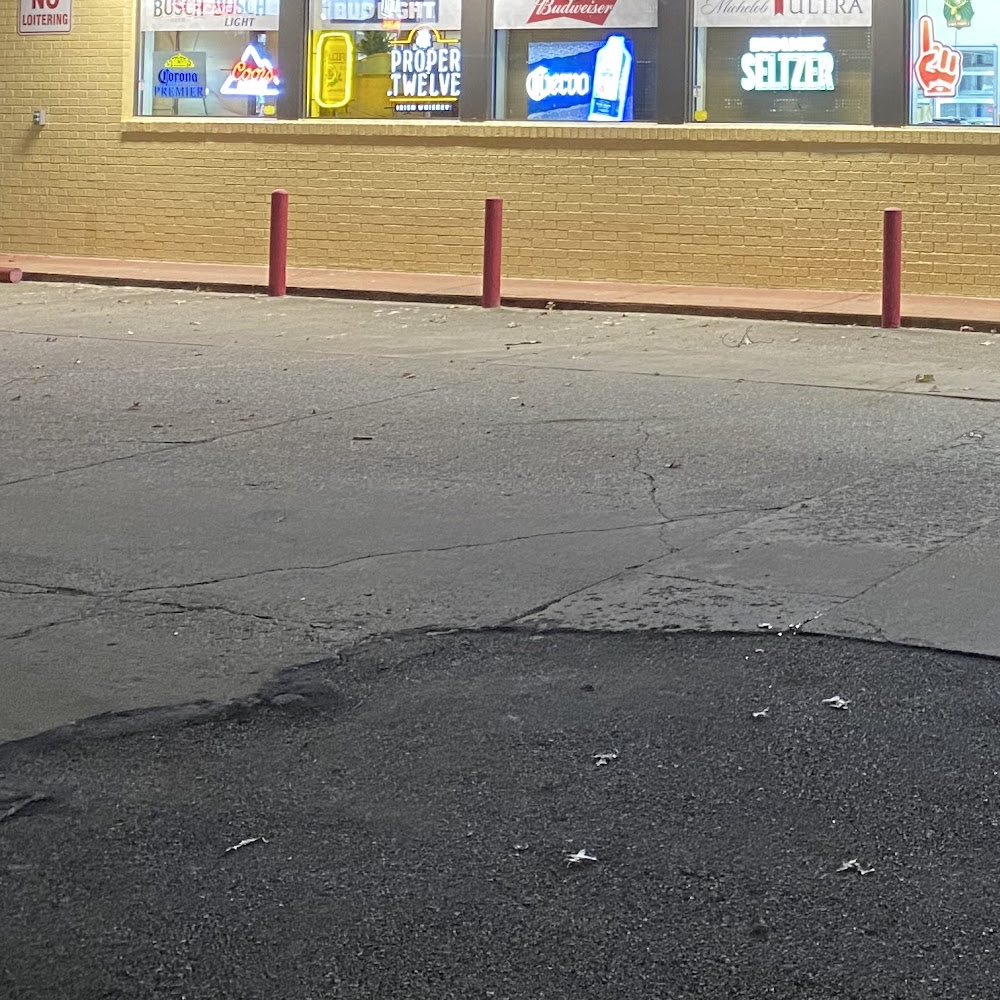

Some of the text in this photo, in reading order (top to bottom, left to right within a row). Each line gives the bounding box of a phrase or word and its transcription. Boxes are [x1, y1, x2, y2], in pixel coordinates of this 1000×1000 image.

[22, 14, 68, 26] LOITERING
[377, 1, 436, 20] LGHT
[224, 17, 255, 27] LIGHT
[390, 48, 461, 73] PROPER
[158, 69, 198, 84] Corona
[232, 61, 275, 81] Coors
[740, 52, 835, 91] SELTZER
[154, 86, 204, 97] PREMIER
[390, 73, 461, 98] TWELVE
